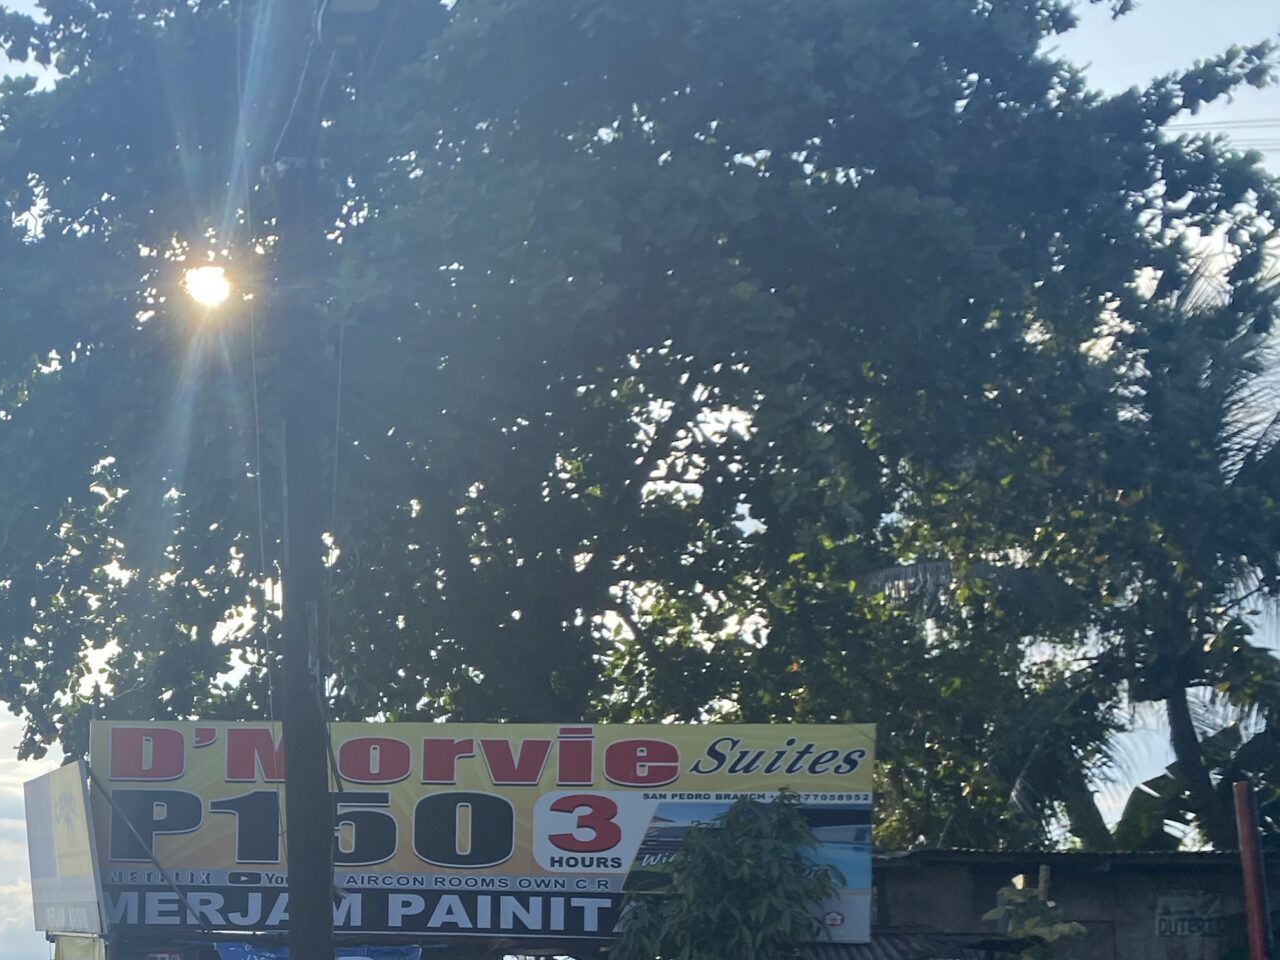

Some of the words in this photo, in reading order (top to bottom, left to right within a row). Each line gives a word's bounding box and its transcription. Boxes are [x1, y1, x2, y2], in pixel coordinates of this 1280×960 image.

[689, 736, 867, 776] Suites
[642, 792, 669, 800] SAN
[671, 792, 711, 800] PEDRO
[715, 792, 767, 801] BRANCH
[548, 794, 623, 853] 3
[550, 855, 623, 869] HOURS
[345, 875, 425, 887] AIRCON
[434, 876, 509, 889] ROOMS
[518, 878, 566, 890] OWN
[575, 879, 610, 890] C.R
[387, 893, 620, 932] PAINIT
